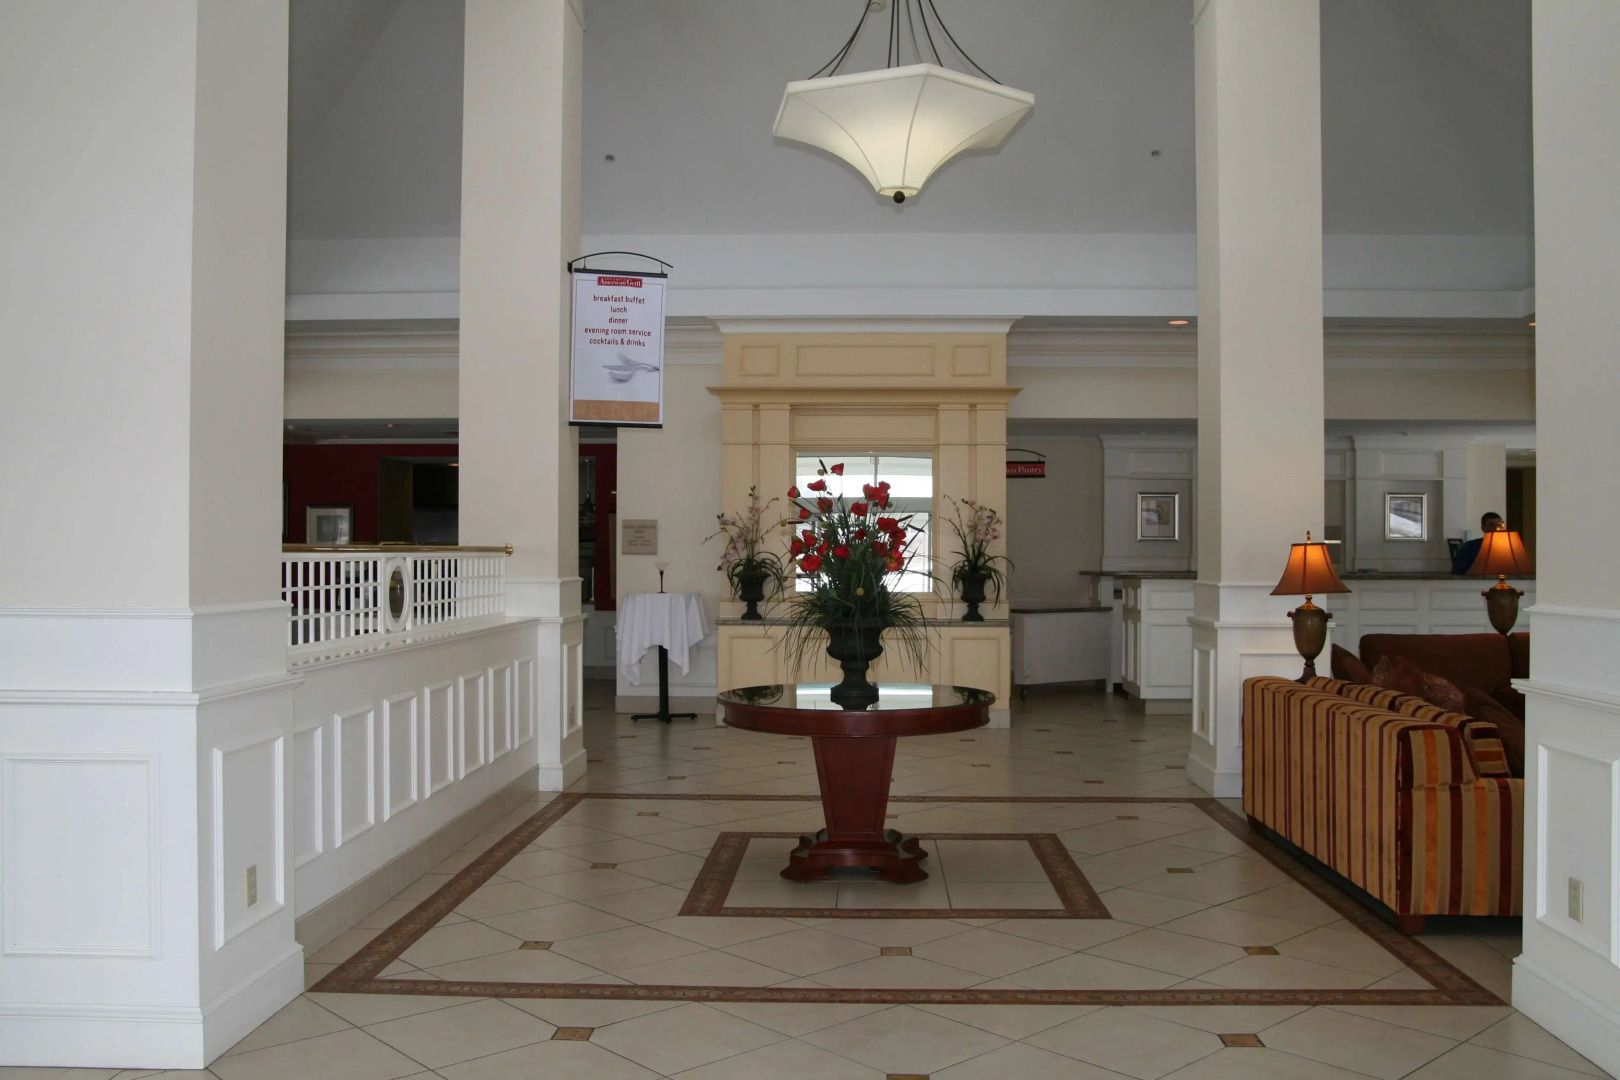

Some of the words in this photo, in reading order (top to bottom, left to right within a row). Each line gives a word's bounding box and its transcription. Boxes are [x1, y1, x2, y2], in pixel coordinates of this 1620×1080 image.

[626, 279, 641, 287] Grill
[593, 294, 624, 303] breakfast
[625, 295, 645, 304] buffet
[608, 316, 629, 324] dinner
[584, 327, 609, 336] evening
[628, 329, 652, 337] service
[589, 337, 619, 346] cocktails
[620, 338, 625, 346] &
[626, 338, 646, 347] drinks
